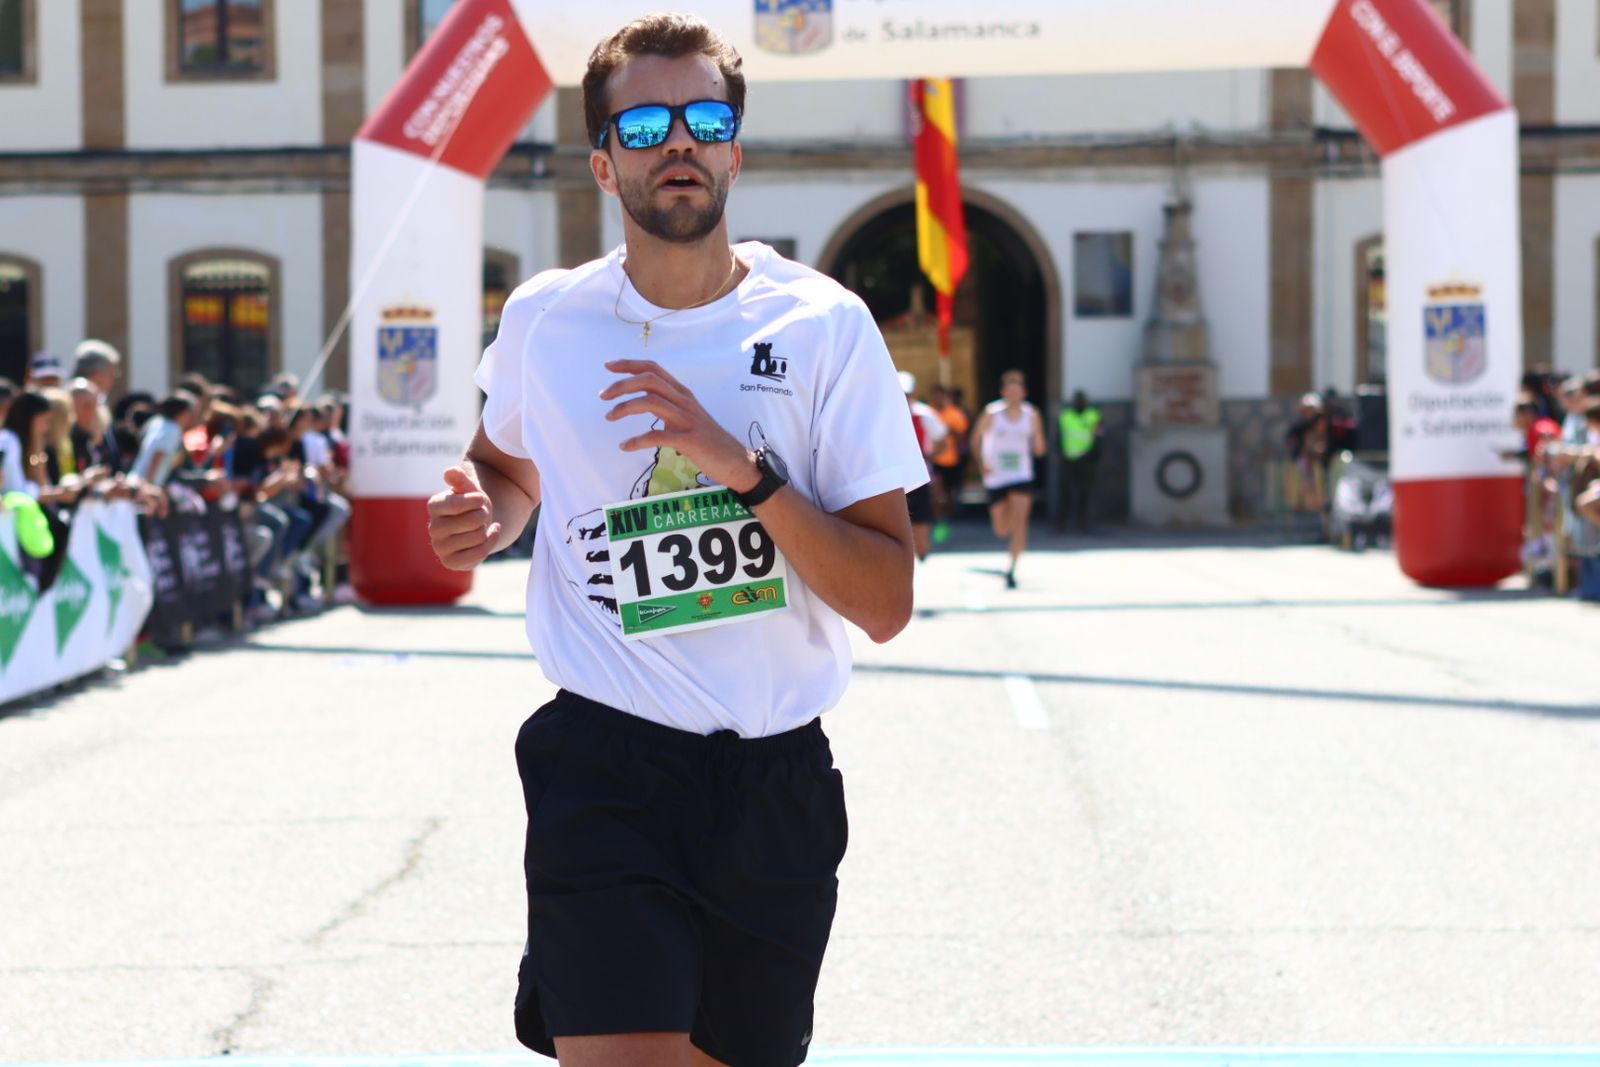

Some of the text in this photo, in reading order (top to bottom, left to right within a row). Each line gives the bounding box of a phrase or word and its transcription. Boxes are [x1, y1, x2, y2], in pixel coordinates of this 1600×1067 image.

[843, 18, 1041, 42] de Salamanca
[739, 384, 794, 397] San Fernando
[610, 505, 648, 536] XIV
[652, 500, 681, 516] SAN
[653, 505, 732, 529] CARRERA
[620, 522, 776, 597] 1399
